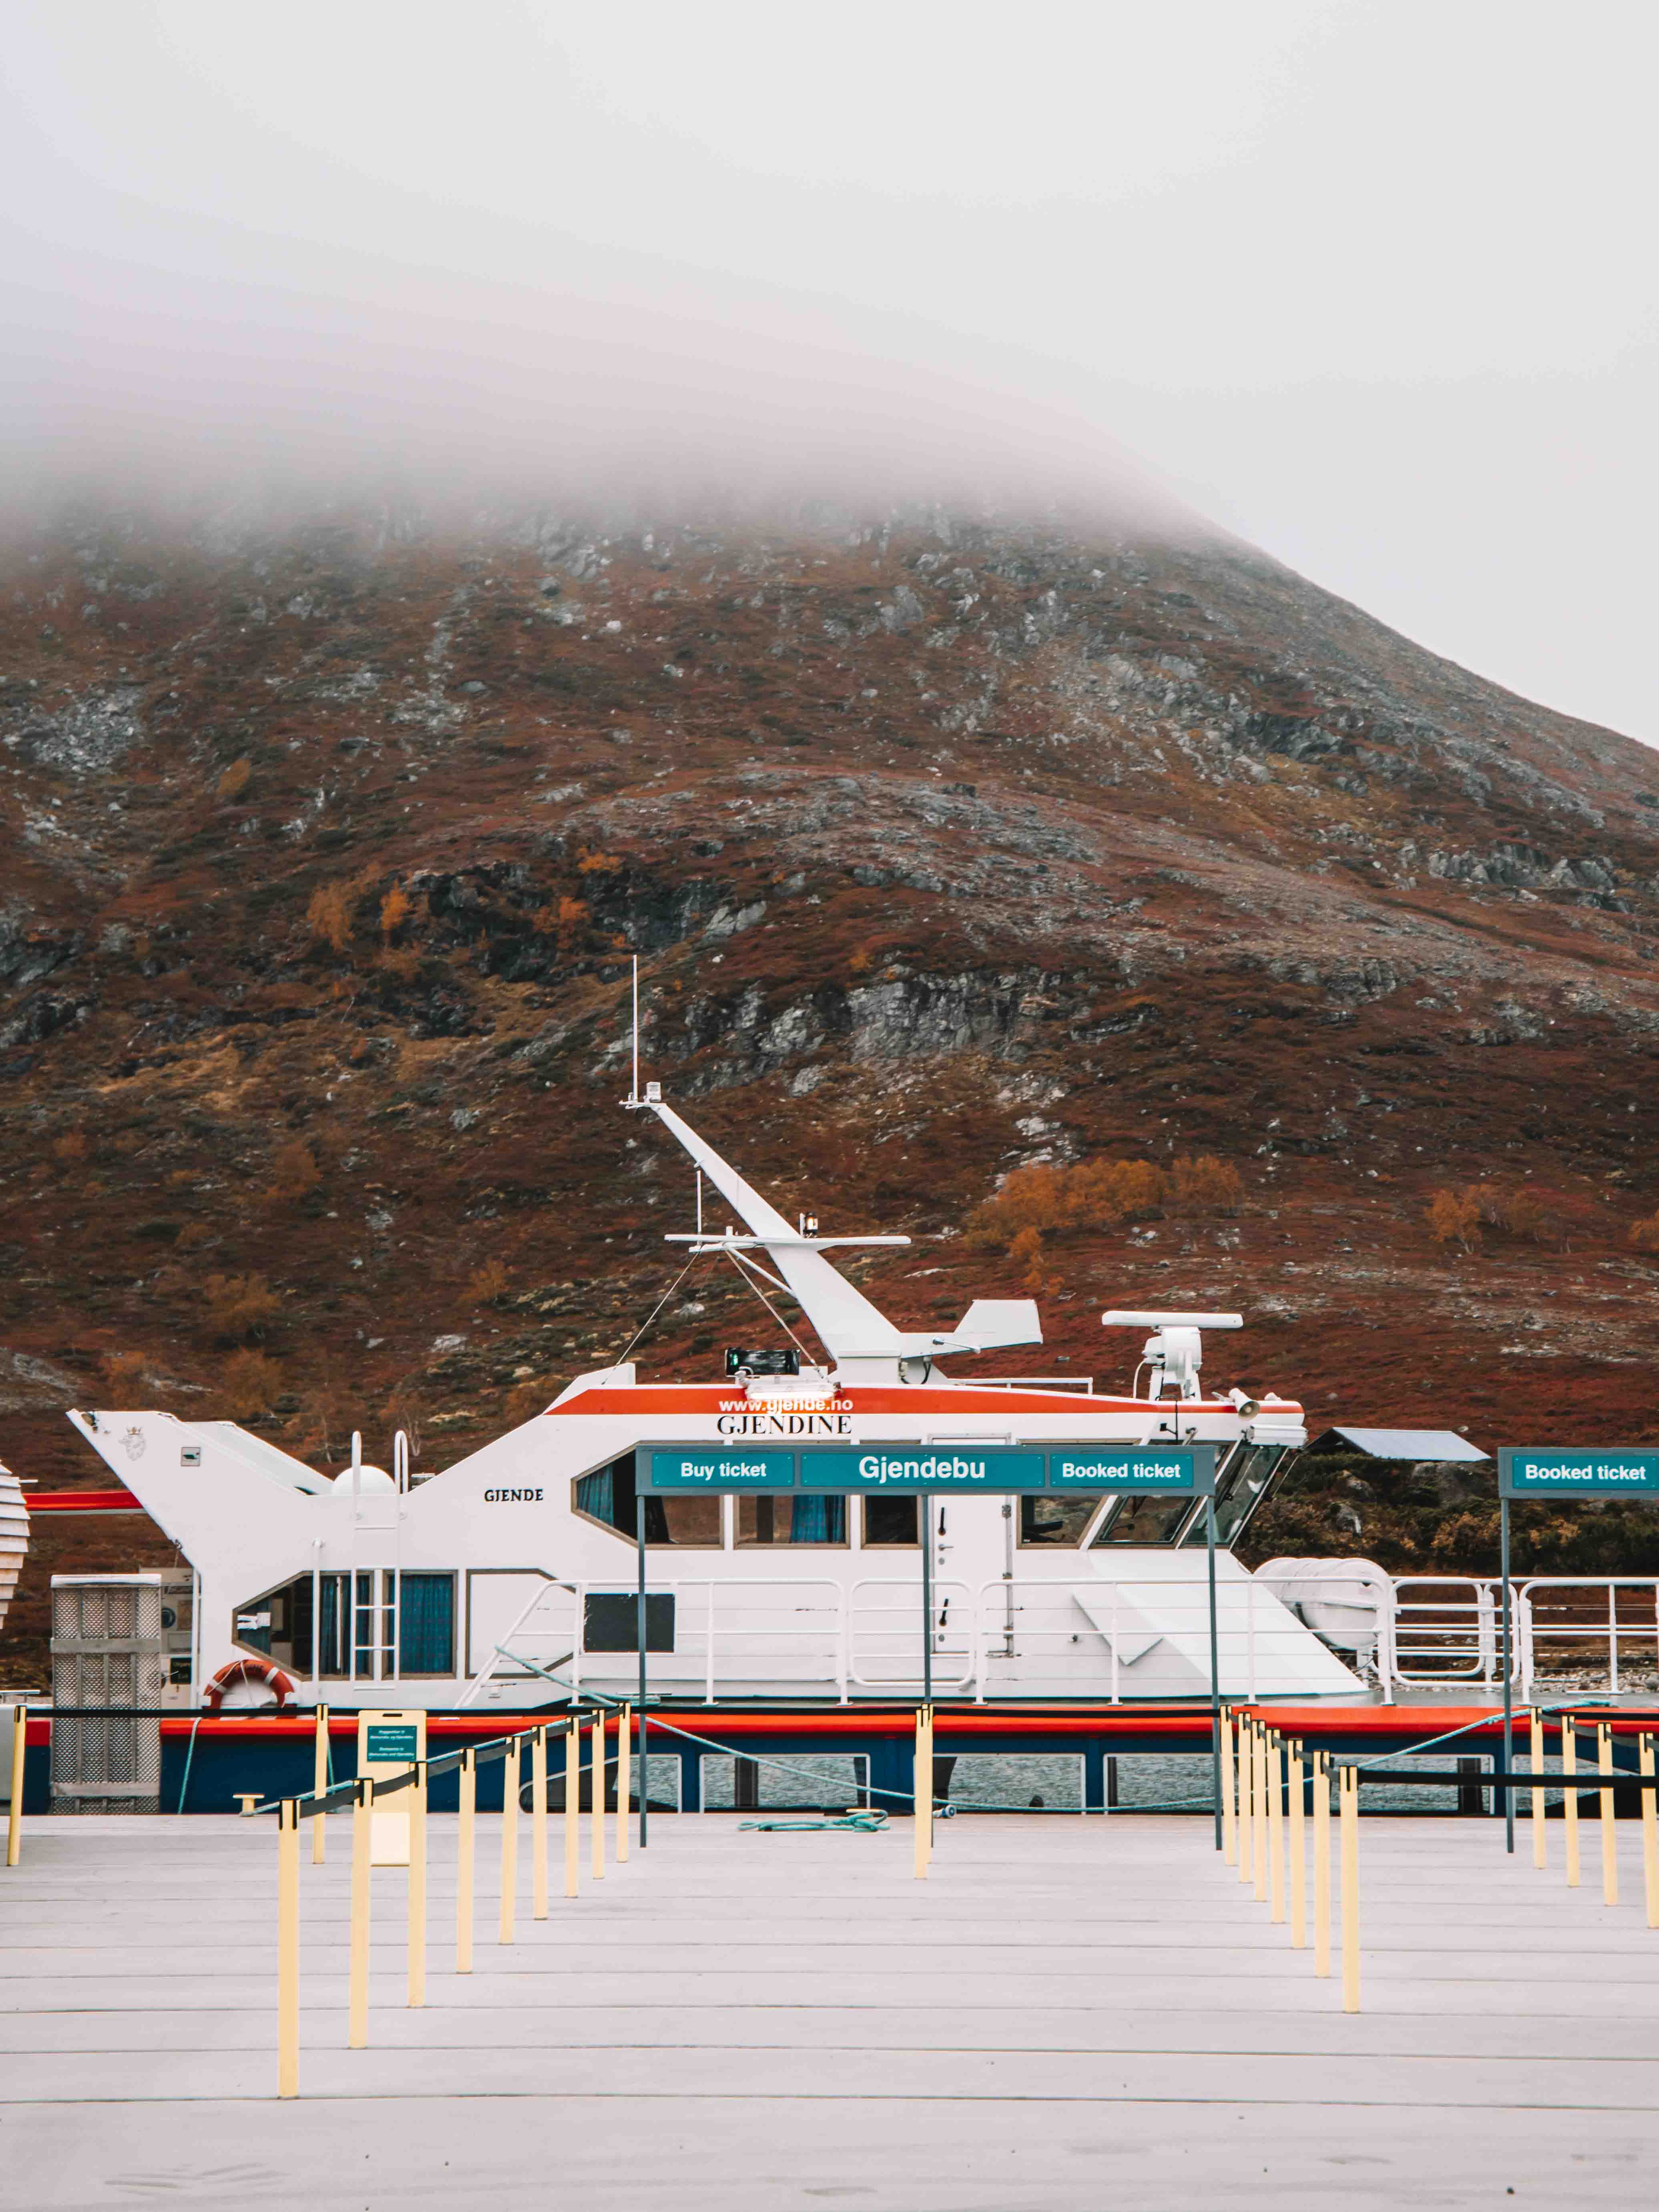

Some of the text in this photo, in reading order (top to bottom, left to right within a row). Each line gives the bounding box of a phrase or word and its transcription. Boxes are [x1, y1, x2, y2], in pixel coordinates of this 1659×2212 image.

[719, 1398, 854, 1414] www.gjende.no
[717, 1416, 852, 1434] GJENDINE
[681, 1462, 767, 1481] Buy ticket
[859, 1456, 985, 1483] Gjendebu
[1062, 1463, 1181, 1478] Booked ticket
[1525, 1465, 1646, 1480] Booked ticket
[484, 1489, 543, 1502] GJENDE
